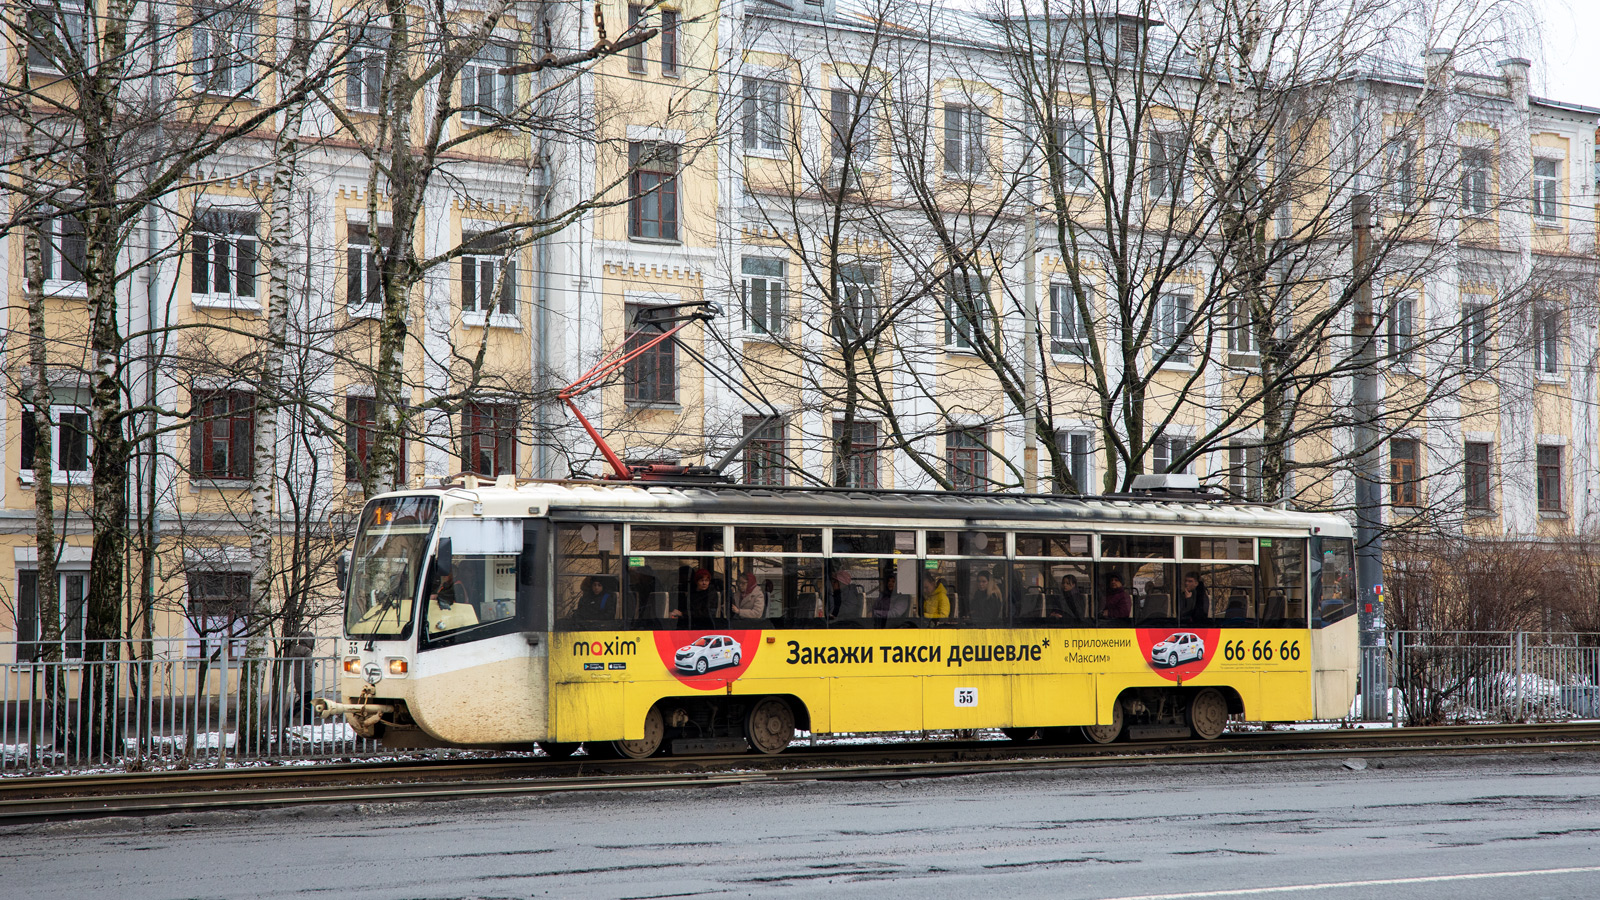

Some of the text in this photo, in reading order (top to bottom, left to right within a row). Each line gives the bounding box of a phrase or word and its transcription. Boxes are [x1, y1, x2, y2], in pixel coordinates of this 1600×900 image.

[348, 641, 359, 655] 55
[1064, 639, 1132, 650] в приложении
[786, 640, 873, 665] Закажи
[880, 645, 941, 663] такси
[1064, 652, 1111, 664] «Максим»
[959, 690, 974, 704] 55
